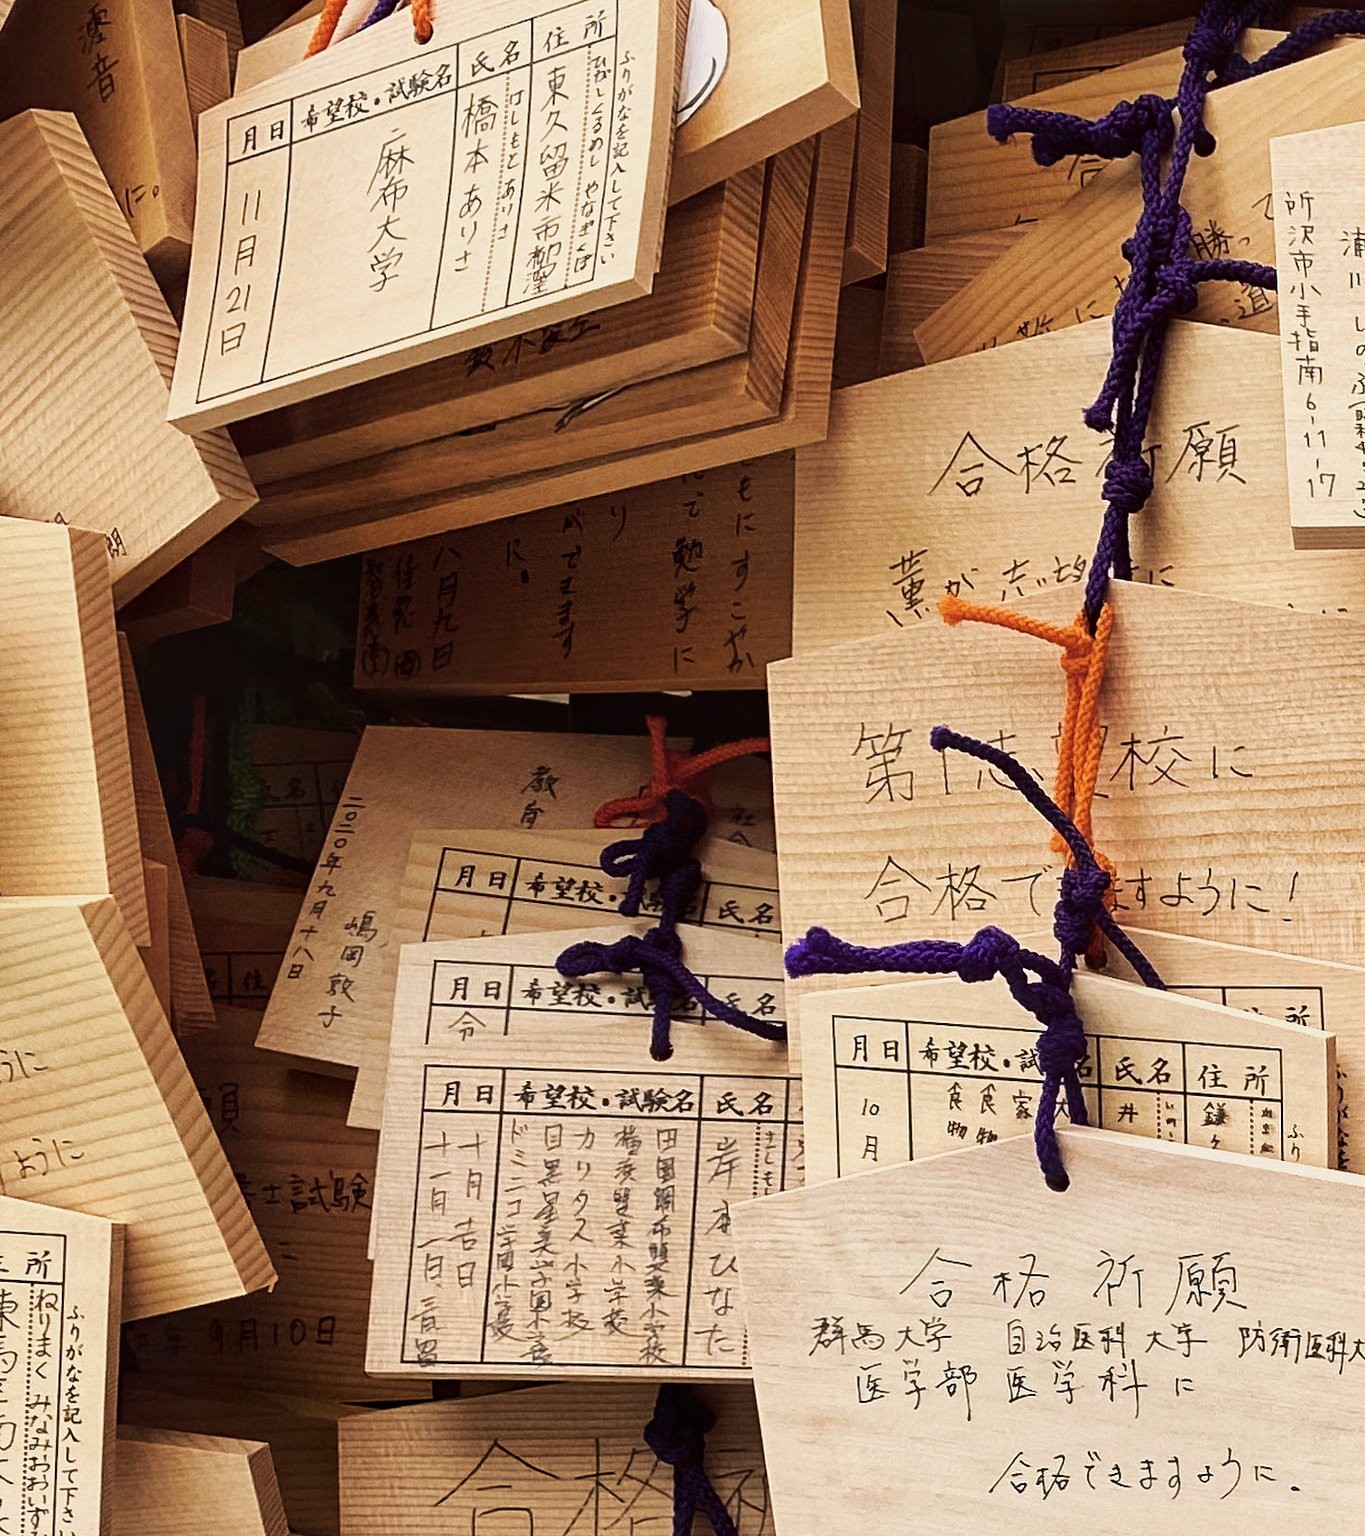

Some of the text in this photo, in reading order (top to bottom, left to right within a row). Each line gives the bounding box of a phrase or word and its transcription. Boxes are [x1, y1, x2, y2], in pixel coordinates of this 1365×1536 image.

[451, 977, 501, 999] 月日
[851, 1035, 1270, 1093] 月日 氏名 住所
[442, 1081, 494, 1106] 月日
[716, 1094, 773, 1116] 氏名
[899, 1248, 1246, 1315] 合格祈願
